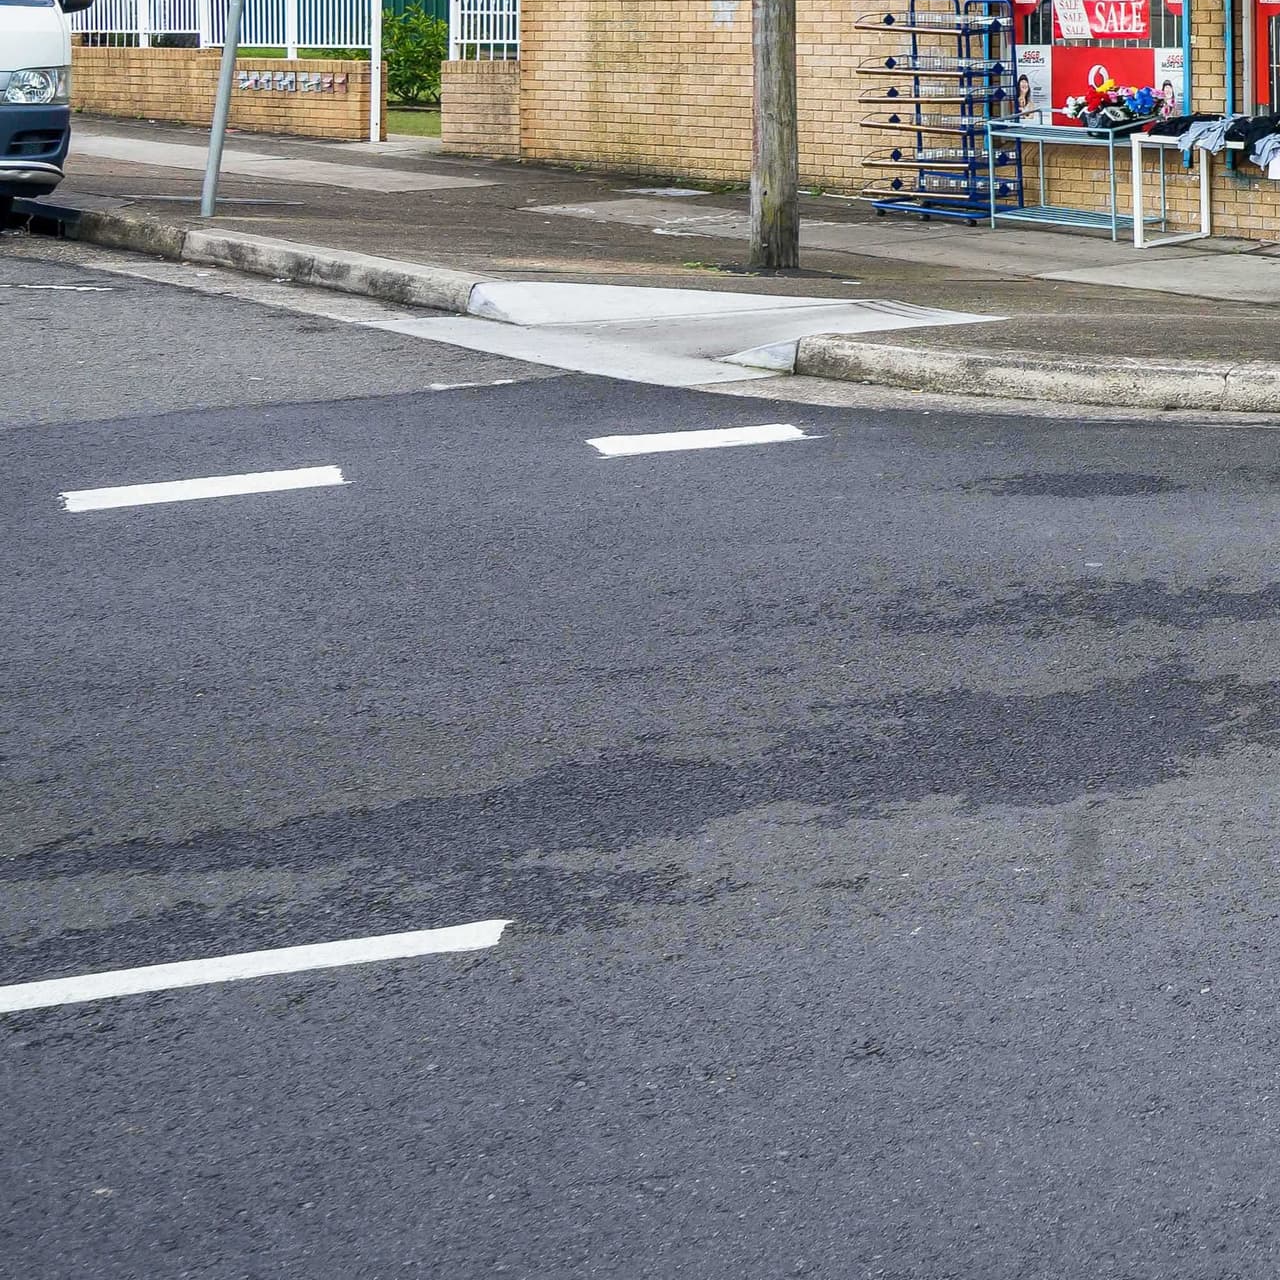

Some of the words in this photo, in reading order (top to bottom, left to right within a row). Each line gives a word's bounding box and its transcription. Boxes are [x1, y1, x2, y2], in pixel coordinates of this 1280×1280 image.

[1059, 0, 1079, 10] SALE
[1063, 12, 1082, 21] SALE
[1094, 0, 1144, 33] SALE
[1066, 25, 1086, 35] SALE
